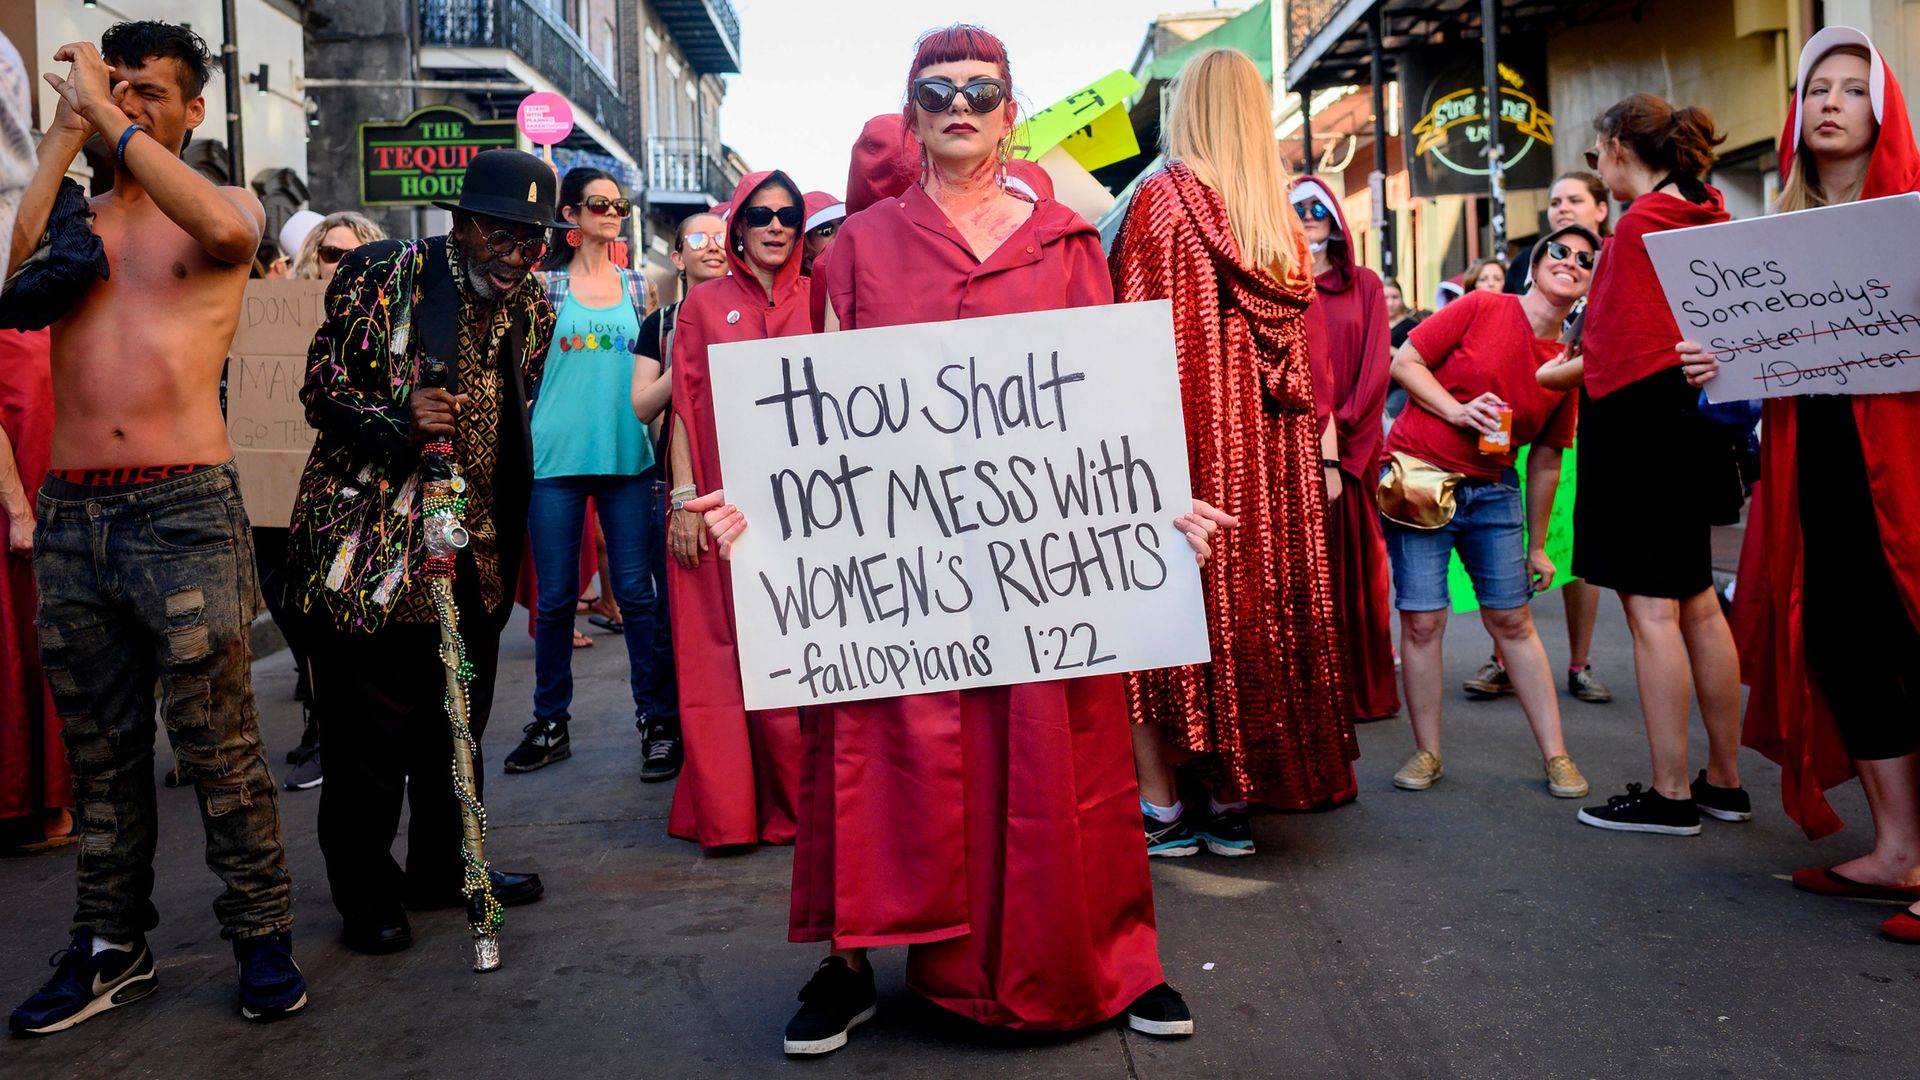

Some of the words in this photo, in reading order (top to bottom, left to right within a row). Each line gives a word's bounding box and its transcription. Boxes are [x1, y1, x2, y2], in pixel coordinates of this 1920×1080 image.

[420, 122, 465, 139] THE
[372, 145, 480, 173] TEQUI
[1689, 259, 1786, 297] She's
[247, 291, 323, 328] DON'T
[1682, 279, 1889, 328] Somebodys
[589, 320, 626, 335] love
[769, 454, 874, 541] not
[888, 454, 1039, 538] MESS
[758, 545, 974, 636] WOMEN'S
[987, 522, 1168, 612] RIGHTS
[1024, 621, 1117, 674] 1:22
